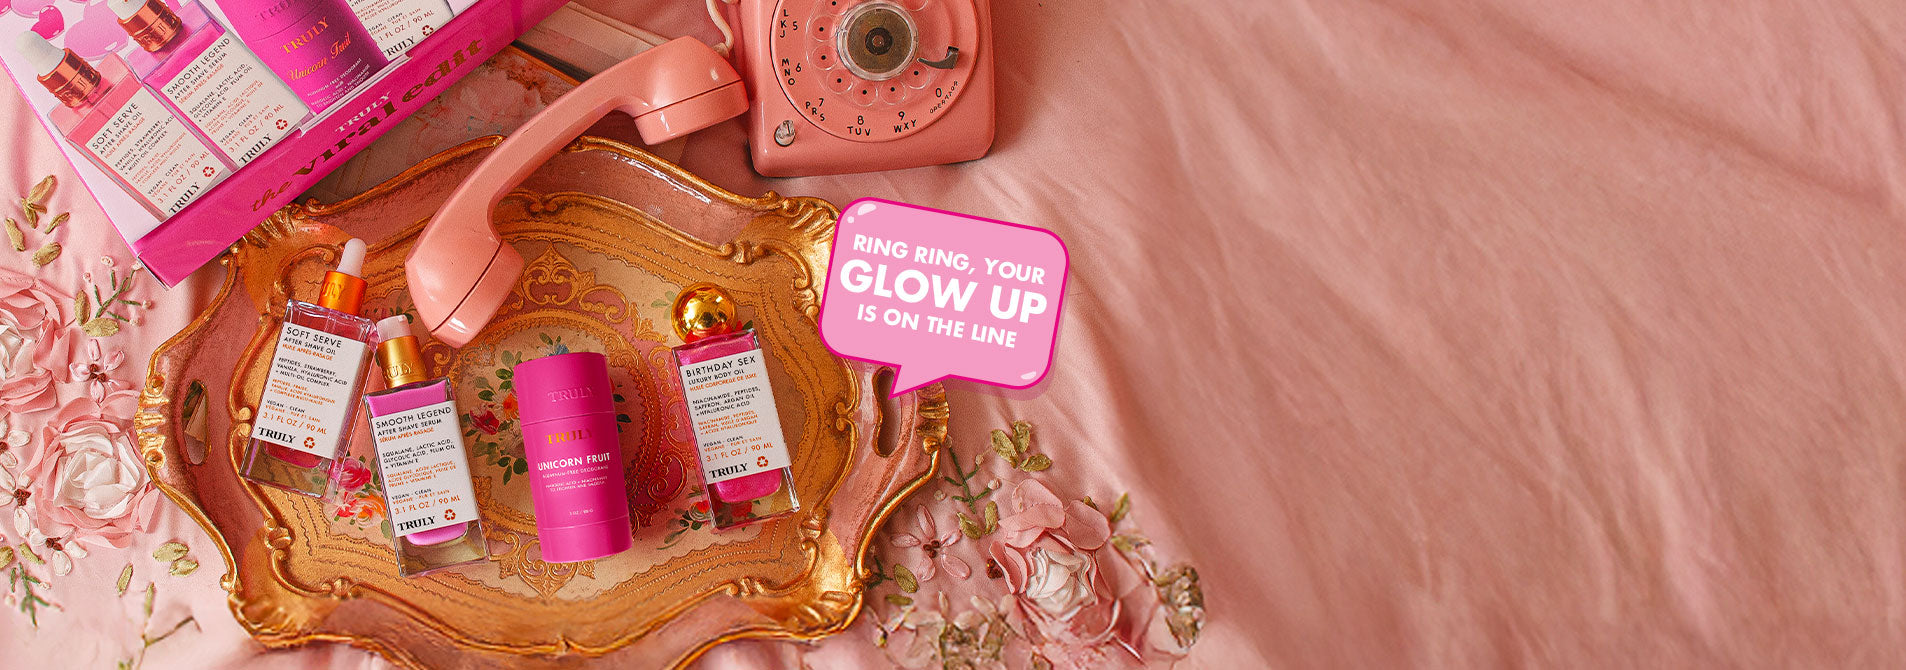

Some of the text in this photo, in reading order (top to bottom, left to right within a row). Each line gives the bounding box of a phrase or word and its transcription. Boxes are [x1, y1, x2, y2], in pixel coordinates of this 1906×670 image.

[368, 21, 382, 32] EGAN
[394, 24, 405, 33] OZ
[412, 14, 422, 24] 90
[423, 9, 434, 18] ML
[792, 21, 798, 30] 5
[280, 17, 330, 55] TRULY
[166, 37, 230, 95] SMOOTH LEGEND
[173, 51, 227, 100] AFTER SHAVE SERUM
[288, 58, 327, 81] Unicorn
[795, 63, 801, 73] 6
[819, 98, 824, 107] 7
[929, 81, 958, 114] OPERATOR
[240, 134, 248, 142] FL
[247, 125, 259, 136] OZ
[263, 111, 274, 121] 90
[273, 102, 284, 113] ML
[335, 91, 393, 133] TRULY
[857, 115, 864, 125] 8
[898, 111, 905, 120] 9
[90, 102, 139, 149] SOFT SERVE
[98, 110, 142, 154] AFTER SHAVE OIL
[219, 128, 235, 143] VEGAN
[238, 113, 252, 127] CLEAN
[251, 38, 483, 212] the viral edit
[238, 132, 273, 165] TRULY
[147, 179, 163, 194] VEGAN
[164, 162, 179, 176] CLEAN
[167, 184, 176, 192] FL
[174, 173, 186, 185] OZ
[189, 159, 200, 169] 90
[198, 150, 209, 160] ML
[166, 181, 202, 215] TRULY
[283, 336, 336, 355] AFTER SHAVE OIL
[285, 326, 342, 348] SOFT SERVE
[685, 355, 756, 377] BIRTHDAY SEX
[688, 375, 712, 384] LUXURY
[713, 371, 732, 379] BODY
[266, 399, 284, 407] VEGAN
[547, 385, 593, 403] TRULY
[723, 395, 744, 404] ARGAN
[262, 411, 327, 434] 3.1 FL OZ 90 ML
[375, 406, 452, 428] SMOOTH LEGEND
[377, 418, 442, 436] AFTER SHAVE SERUM
[257, 426, 295, 444] TRULY
[545, 427, 592, 445] TRULY
[705, 453, 718, 461] 3.1
[730, 448, 741, 456] OZ
[750, 444, 760, 452] 90
[762, 441, 773, 449] ML
[390, 459, 413, 468] VITAMIN
[537, 452, 610, 471] UNICORN FRUIT
[708, 462, 749, 478] TRULY
[391, 487, 431, 500] VEGAN CLEAN
[394, 506, 405, 514] 3.1
[418, 501, 429, 509] OZ
[450, 494, 460, 502] ML
[396, 515, 436, 531] TRULY
